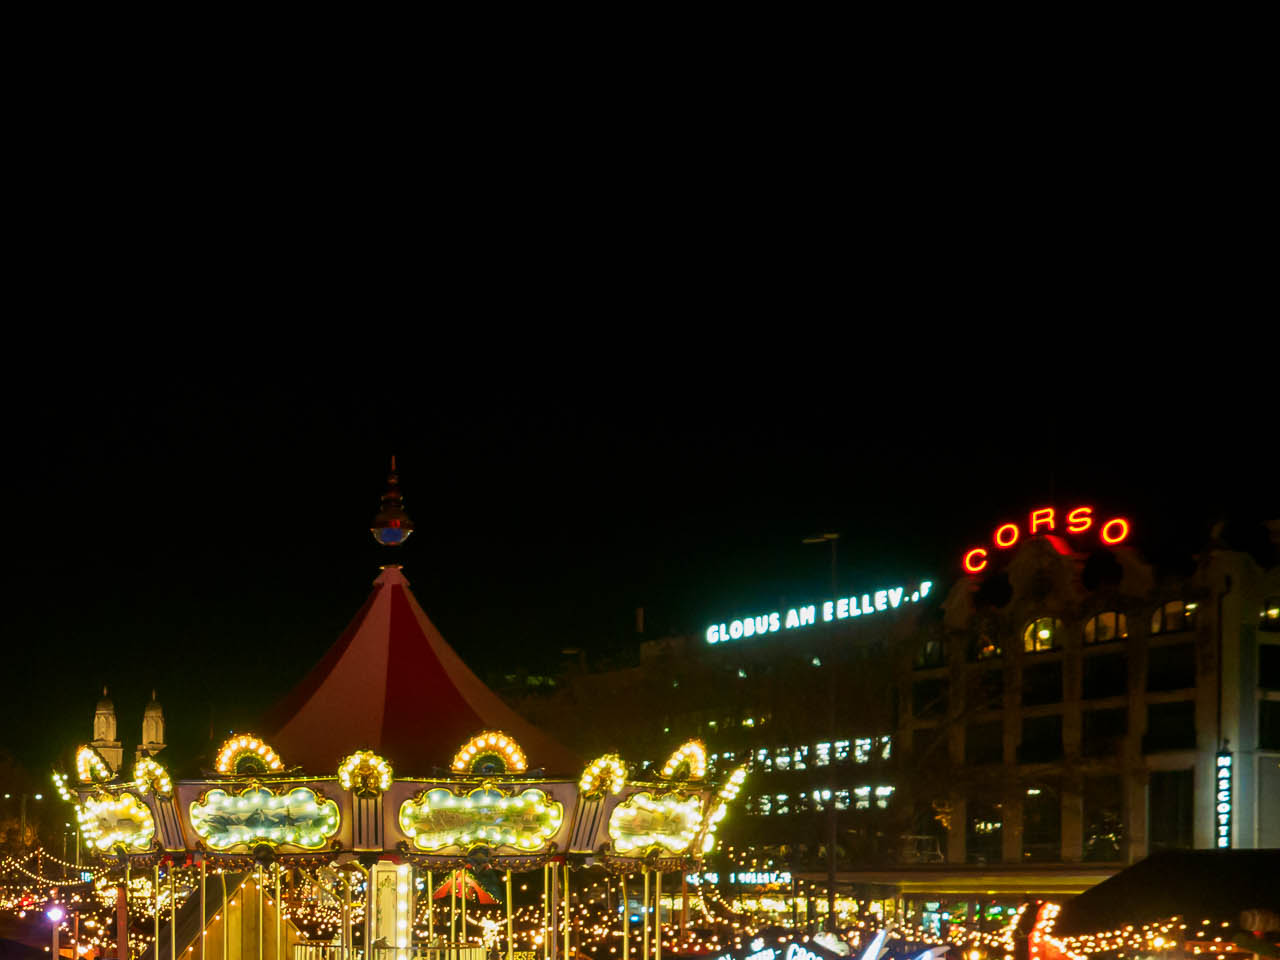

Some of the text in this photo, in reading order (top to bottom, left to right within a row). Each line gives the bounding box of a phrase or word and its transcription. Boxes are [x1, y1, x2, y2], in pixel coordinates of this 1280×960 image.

[963, 505, 1129, 573] CORSO
[706, 612, 780, 643] GLOBUS
[1217, 756, 1231, 848] MASCOTTE
